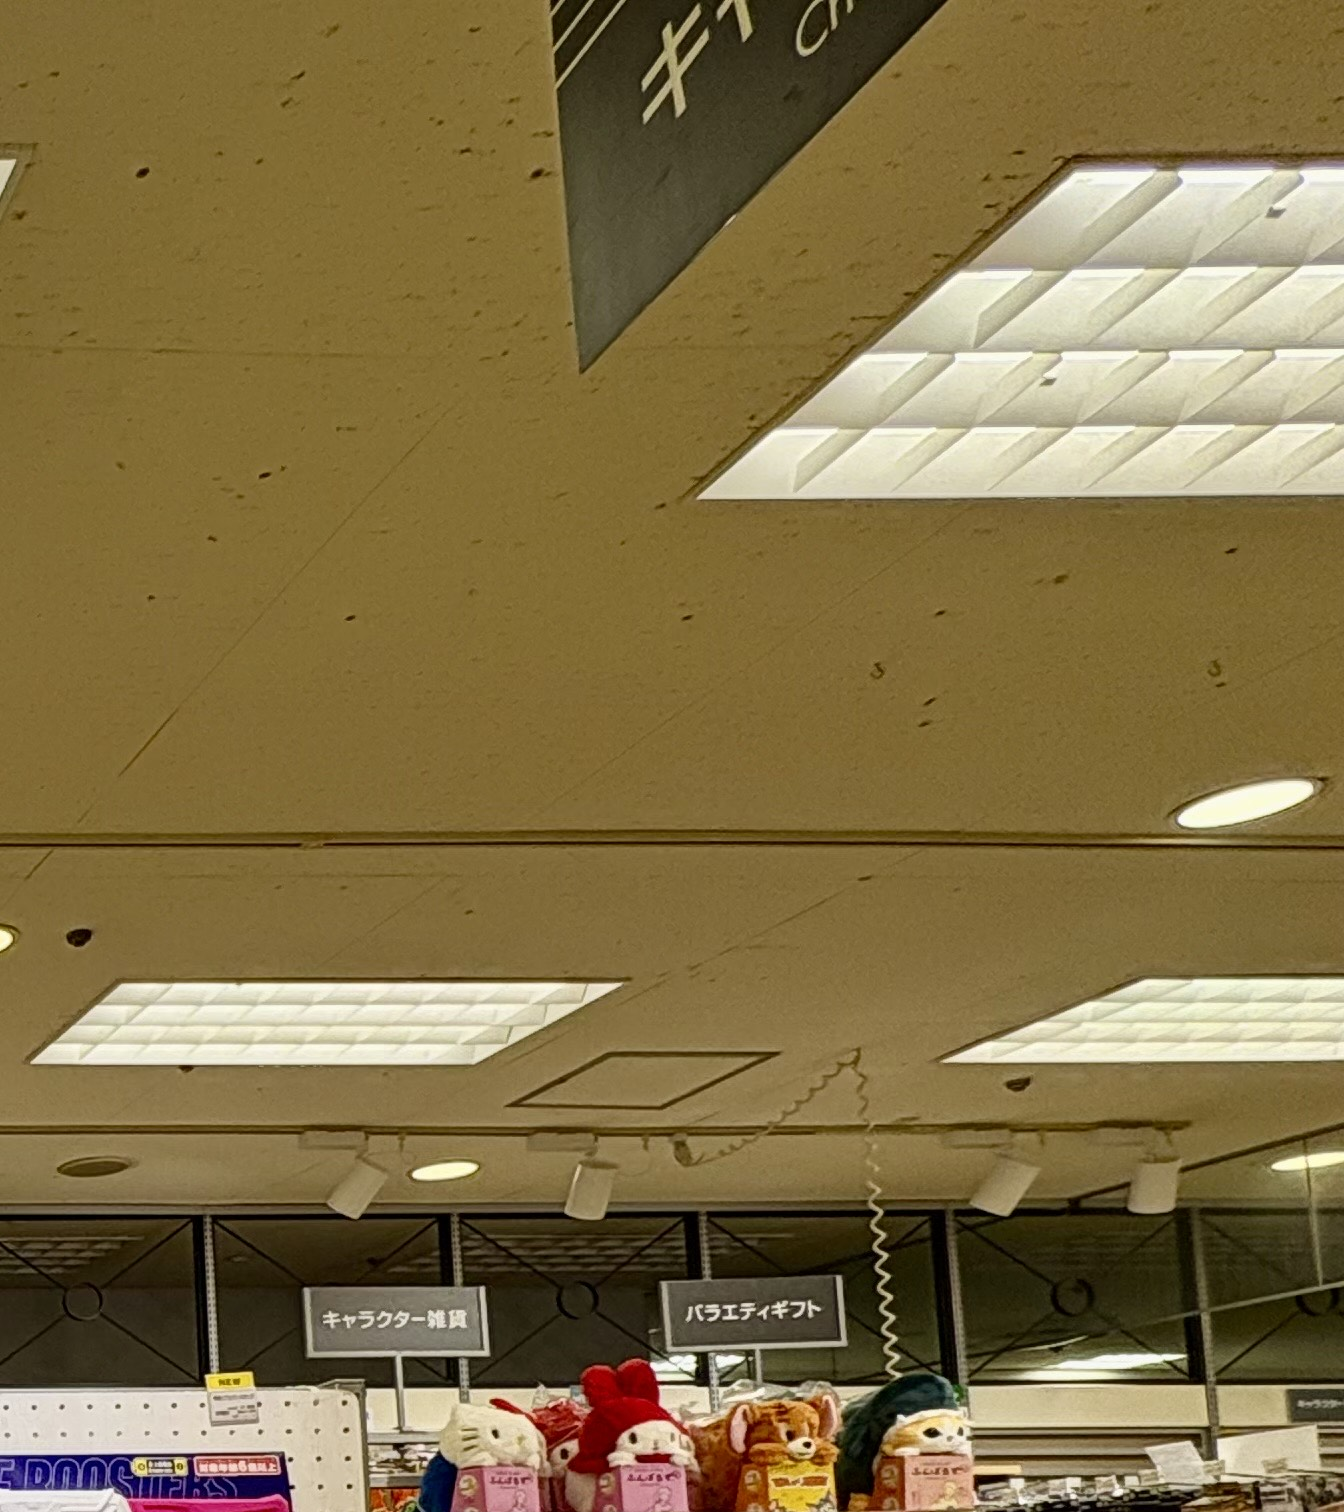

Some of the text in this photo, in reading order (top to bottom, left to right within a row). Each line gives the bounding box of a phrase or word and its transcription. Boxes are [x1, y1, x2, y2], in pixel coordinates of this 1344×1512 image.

[322, 1309, 468, 1330] キャラクター雑貨
[685, 1299, 822, 1323] バラエティギフト
